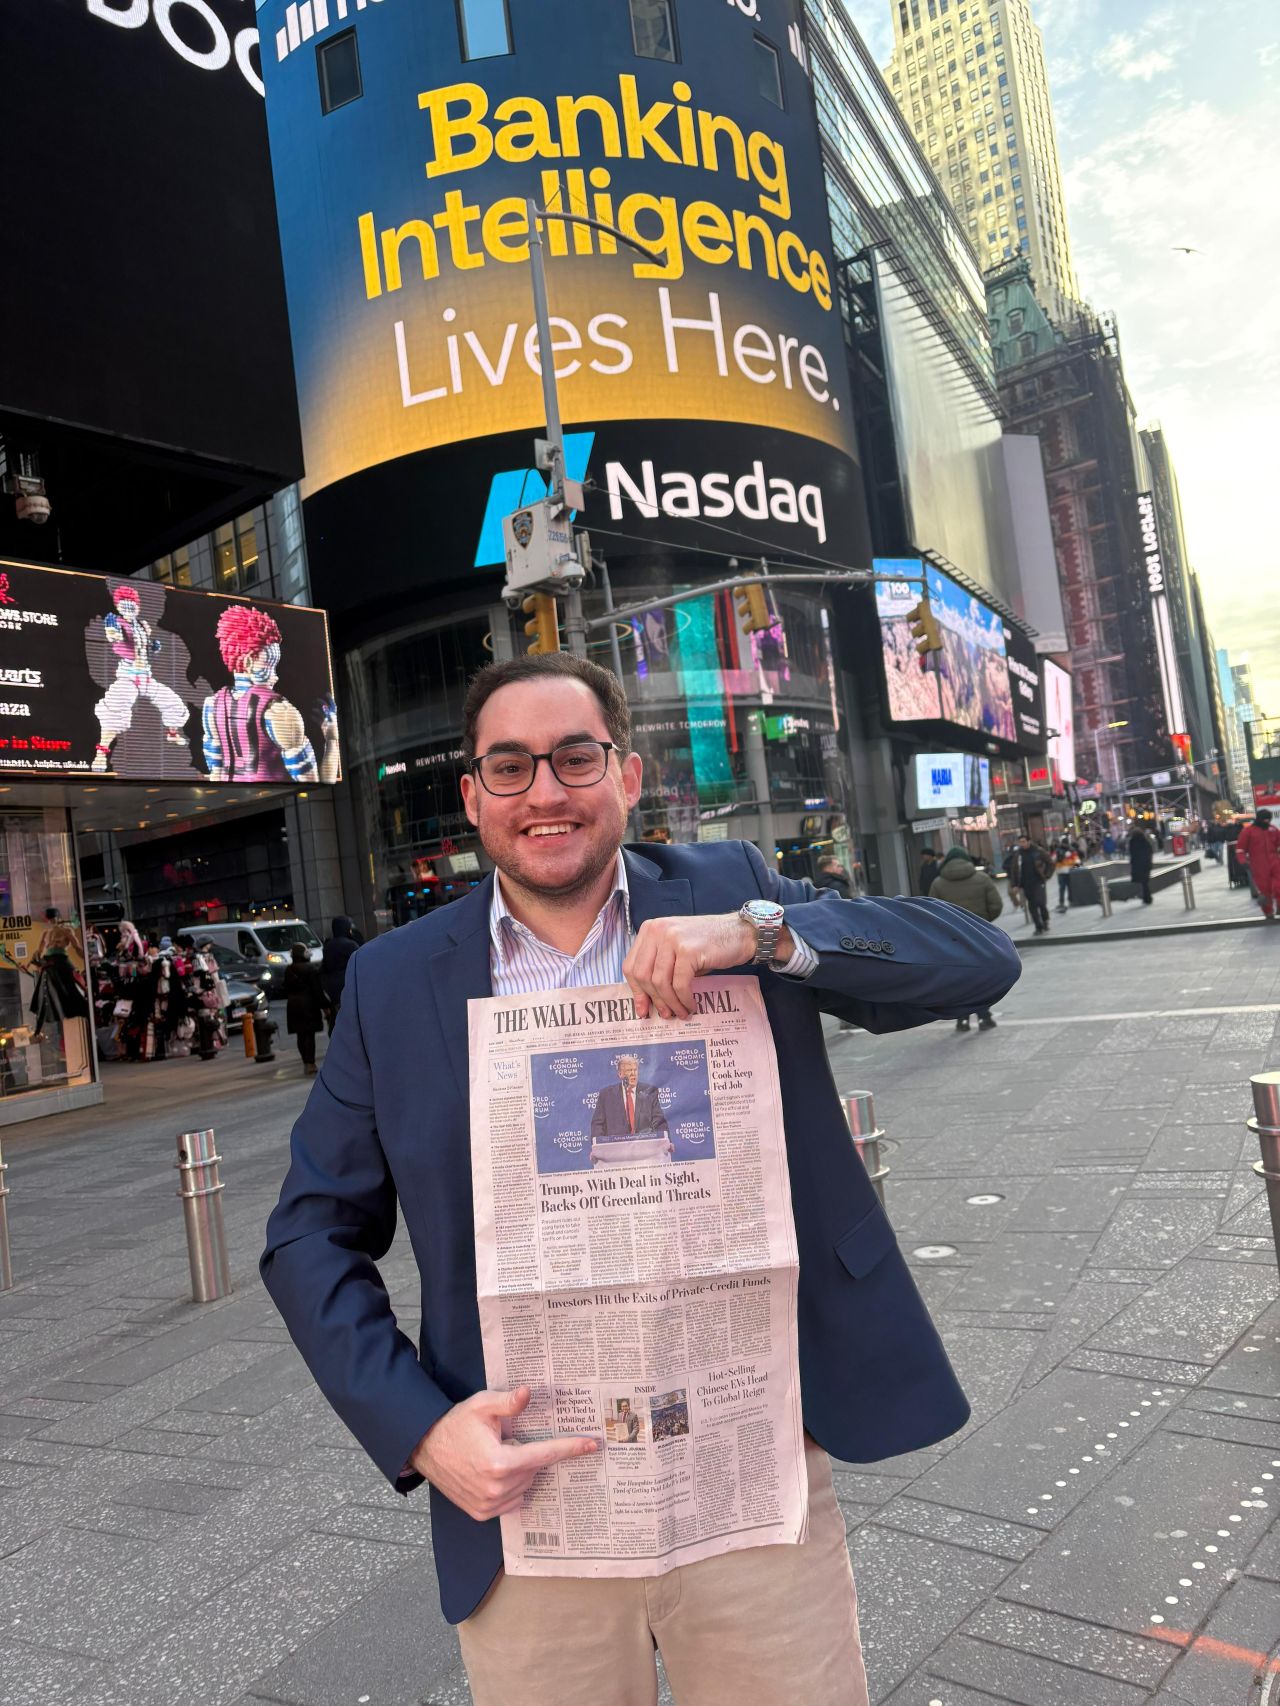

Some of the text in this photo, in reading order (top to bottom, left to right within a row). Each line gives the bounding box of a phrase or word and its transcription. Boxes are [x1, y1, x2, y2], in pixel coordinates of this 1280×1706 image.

[418, 74, 792, 220] Banking
[358, 168, 833, 312] Intelligence
[394, 287, 840, 411] Lives Here.
[605, 460, 827, 544] Nasdaq
[636, 722, 675, 733] REWRITE
[2, 915, 32, 928] ZORO
[493, 1008, 529, 1034] THE
[531, 1002, 582, 1029] WALL
[585, 997, 650, 1025] STRE
[709, 1038, 739, 1047] Justices
[670, 1053, 705, 1062] ECONOMIC
[710, 1049, 733, 1058] Likely
[549, 1062, 583, 1070] ECONOMIC
[711, 1060, 735, 1069] To Let
[497, 1071, 518, 1080] News
[712, 1069, 753, 1079] Cook Keep
[713, 1080, 743, 1091] Fed Job
[675, 1126, 711, 1134] ECONOMIC
[553, 1135, 589, 1144] ECONOMIC
[539, 1170, 700, 1197] Trump, With Deal in Sight,
[541, 1187, 711, 1213] Backs Off Greenland Threats
[547, 1276, 771, 1309] Investors Hit the Exits of Private-Credit Funds
[708, 1364, 756, 1382] Hot-Selling
[697, 1371, 768, 1397] Chinese EVs Head
[555, 1388, 573, 1396] Musk
[568, 1396, 594, 1406] SpaceX
[701, 1387, 765, 1408] To Global Reign
[556, 1407, 571, 1415] IPO
[572, 1406, 588, 1414] Tied
[557, 1415, 586, 1424] Orbiting
[558, 1424, 602, 1433] Data Centers
